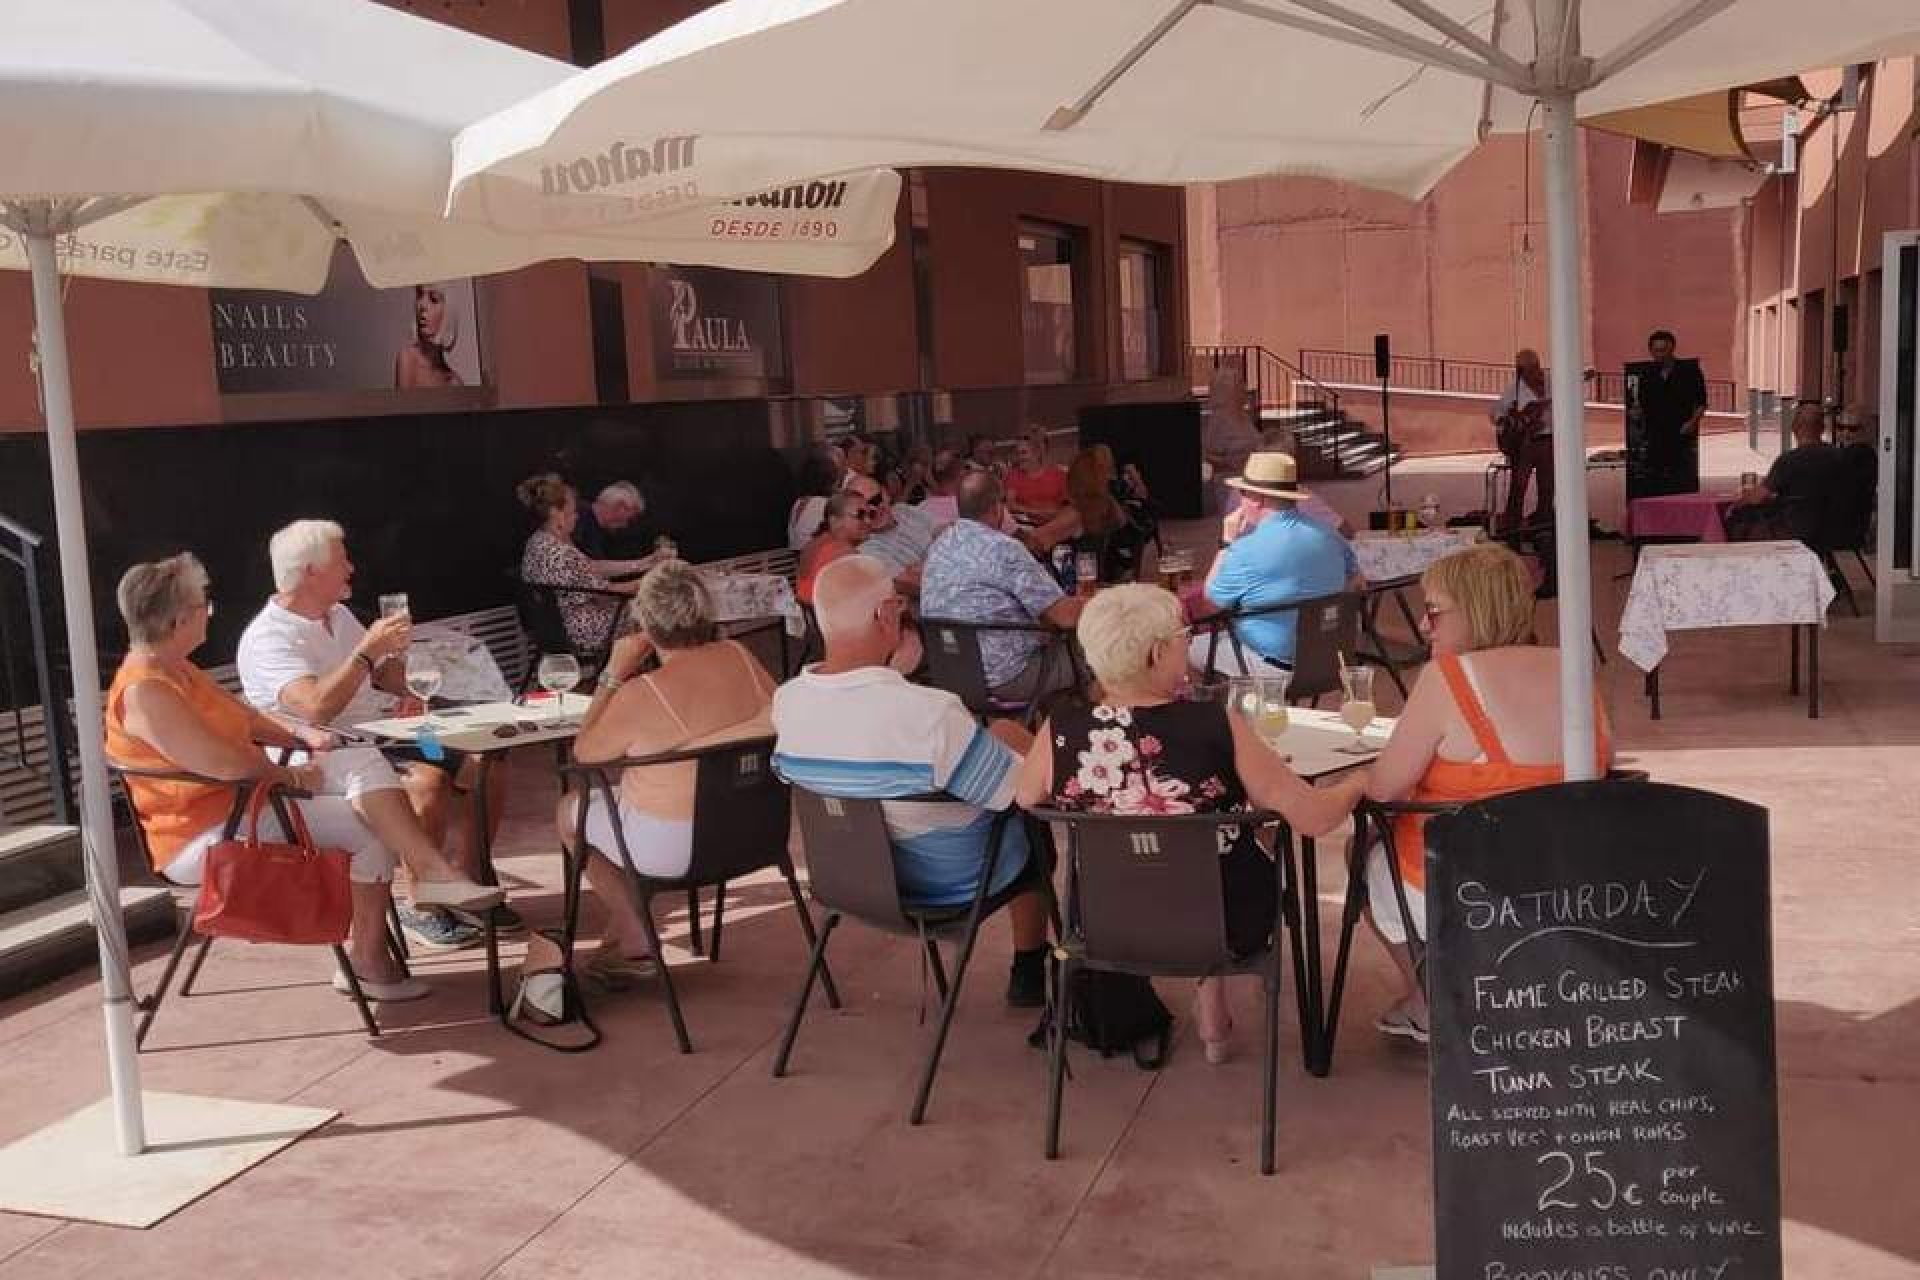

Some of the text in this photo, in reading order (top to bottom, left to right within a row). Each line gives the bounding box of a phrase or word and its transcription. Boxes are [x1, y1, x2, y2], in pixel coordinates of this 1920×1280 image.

[711, 219, 783, 237] DESDE
[214, 303, 307, 329] NAILS
[219, 342, 337, 368] BEAUTY
[1456, 866, 1708, 930] SATURDAY
[1557, 969, 1647, 1003] GRILLED
[1470, 1014, 1690, 1055] CHICKEN BREAST
[1472, 1057, 1663, 1095] TUNA STEAK
[1662, 1165, 1700, 1187] per
[1659, 1185, 1725, 1211] couple
[1607, 1218, 1669, 1237] bottle
